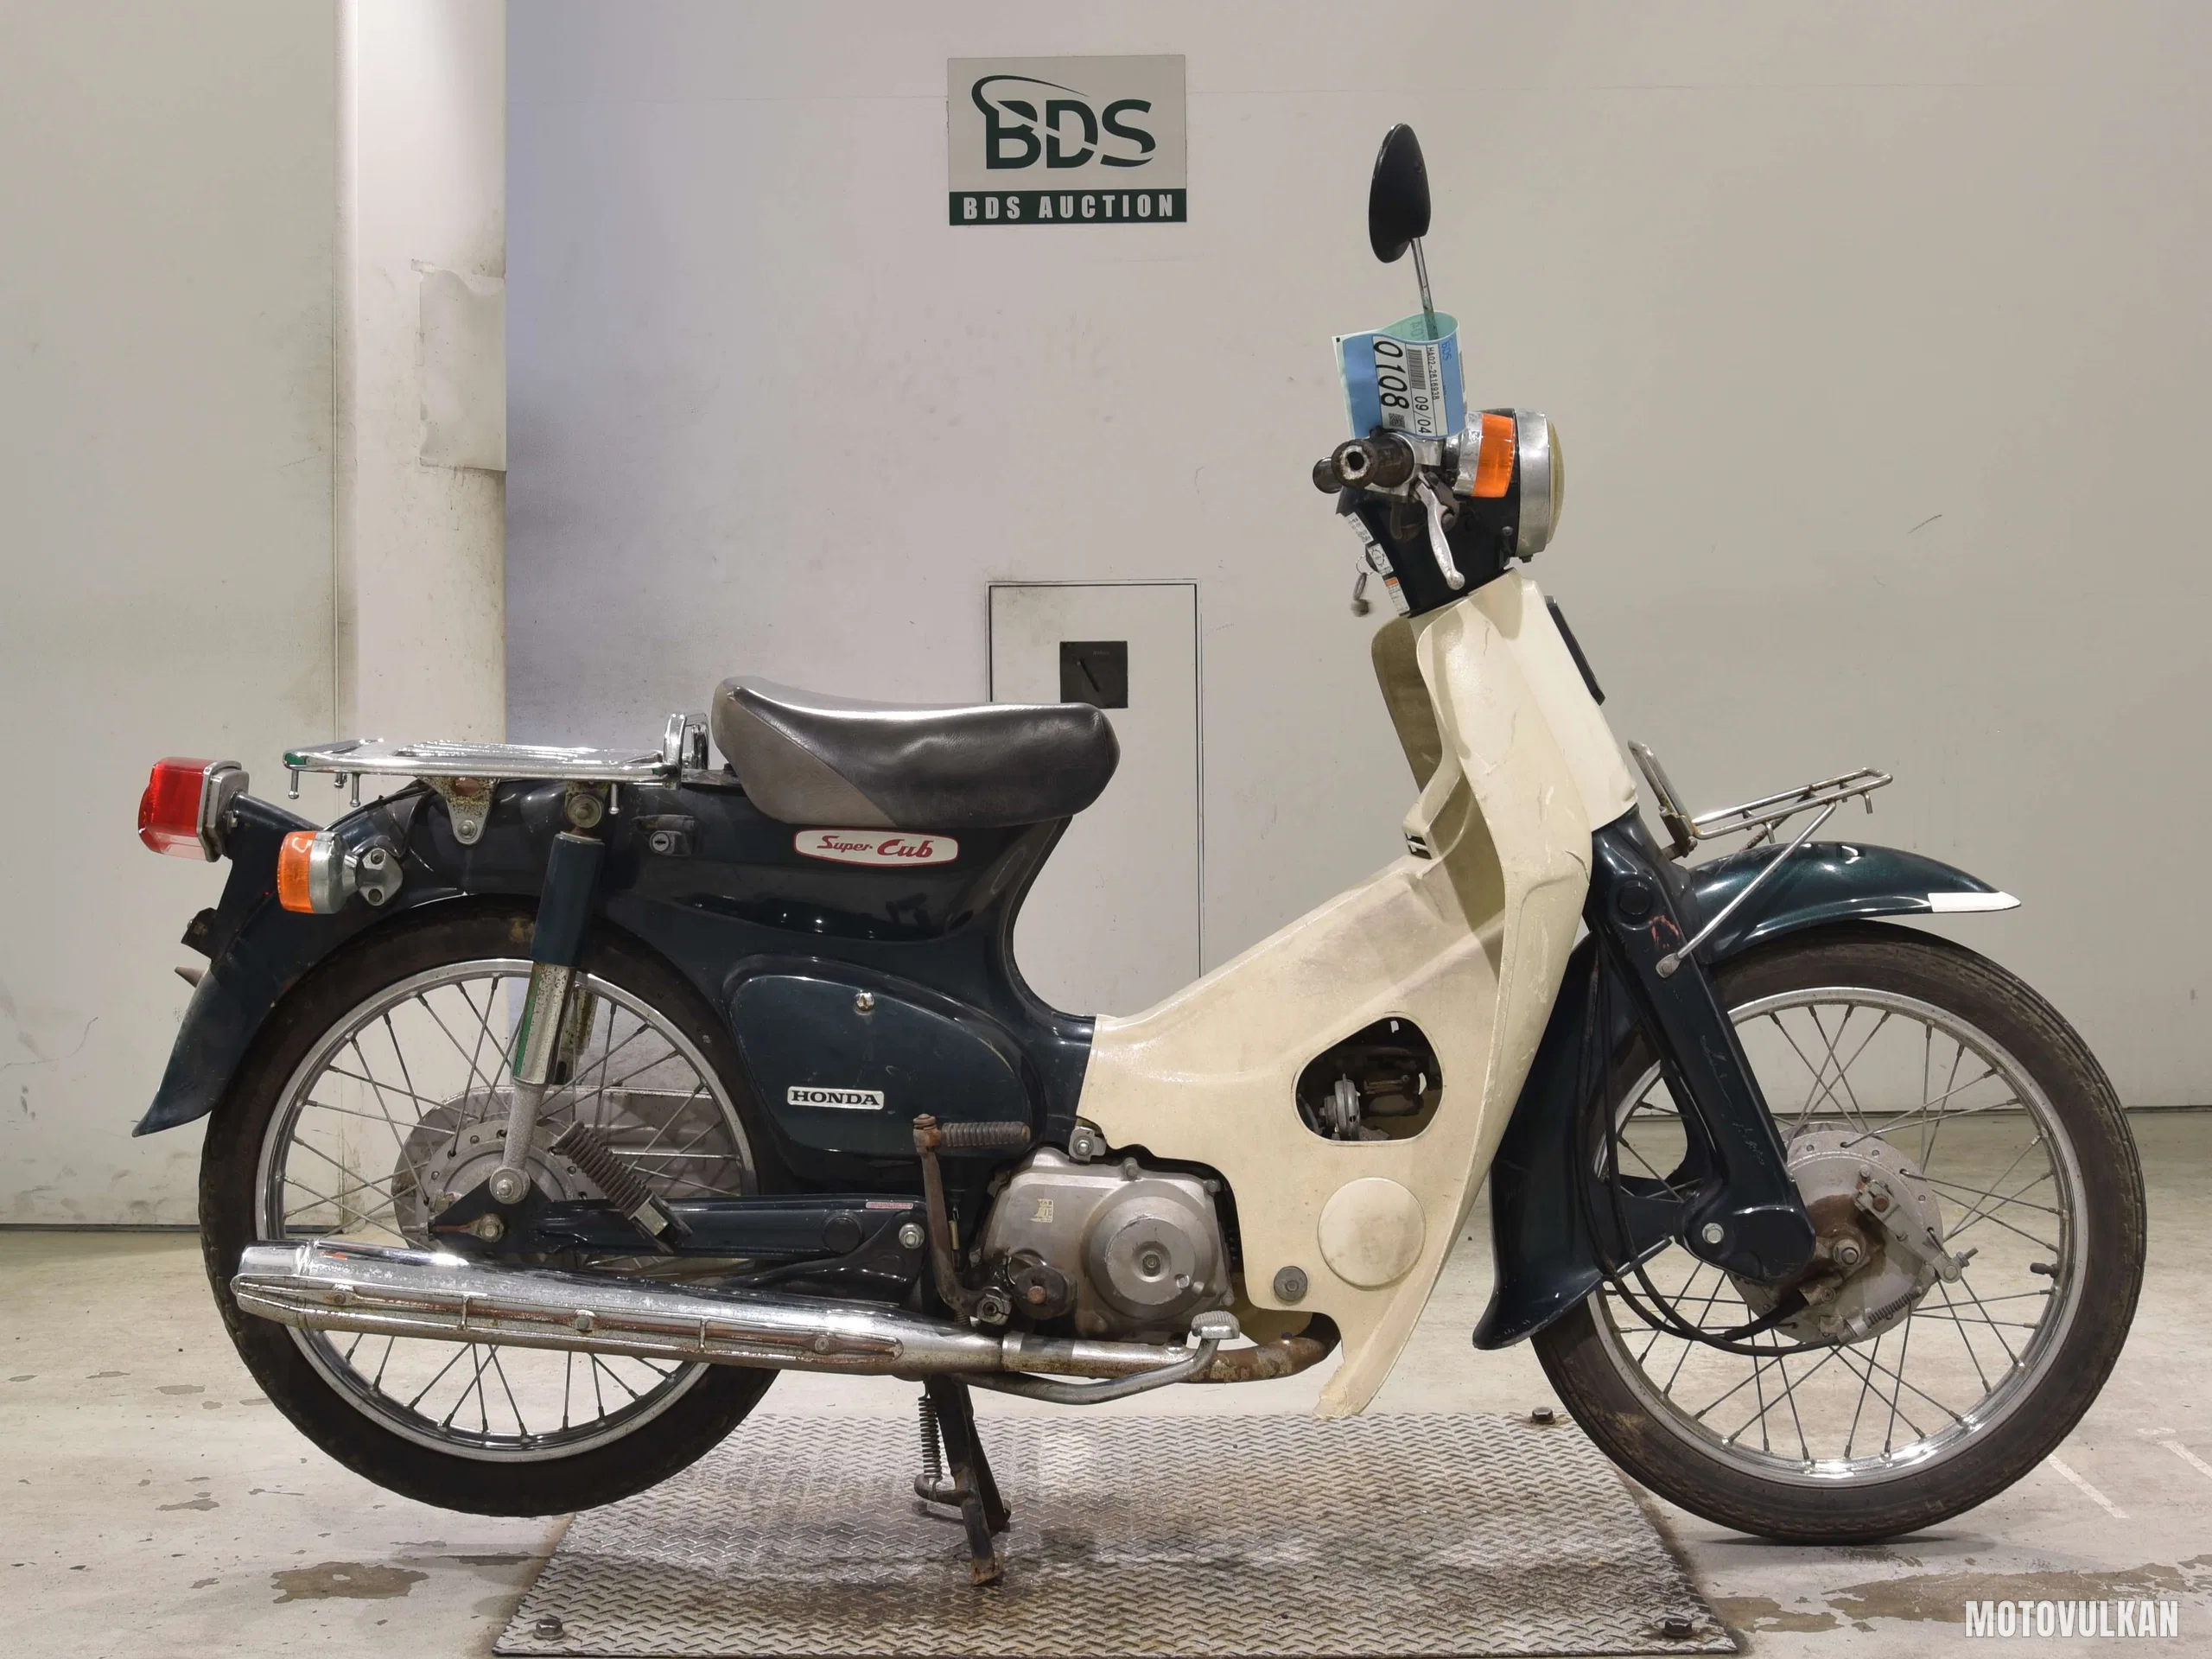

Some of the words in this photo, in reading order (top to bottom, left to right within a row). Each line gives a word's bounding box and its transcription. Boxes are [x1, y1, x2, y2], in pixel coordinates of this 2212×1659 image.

[971, 75, 1156, 169] BDS
[963, 196, 1021, 219] BDS
[1039, 194, 1173, 219] AUCTION
[1373, 340, 1410, 410] 0108
[1414, 396, 1433, 434] 09/04
[817, 835, 873, 853] Super
[877, 838, 934, 858] Cub
[791, 1090, 880, 1106] HONDA
